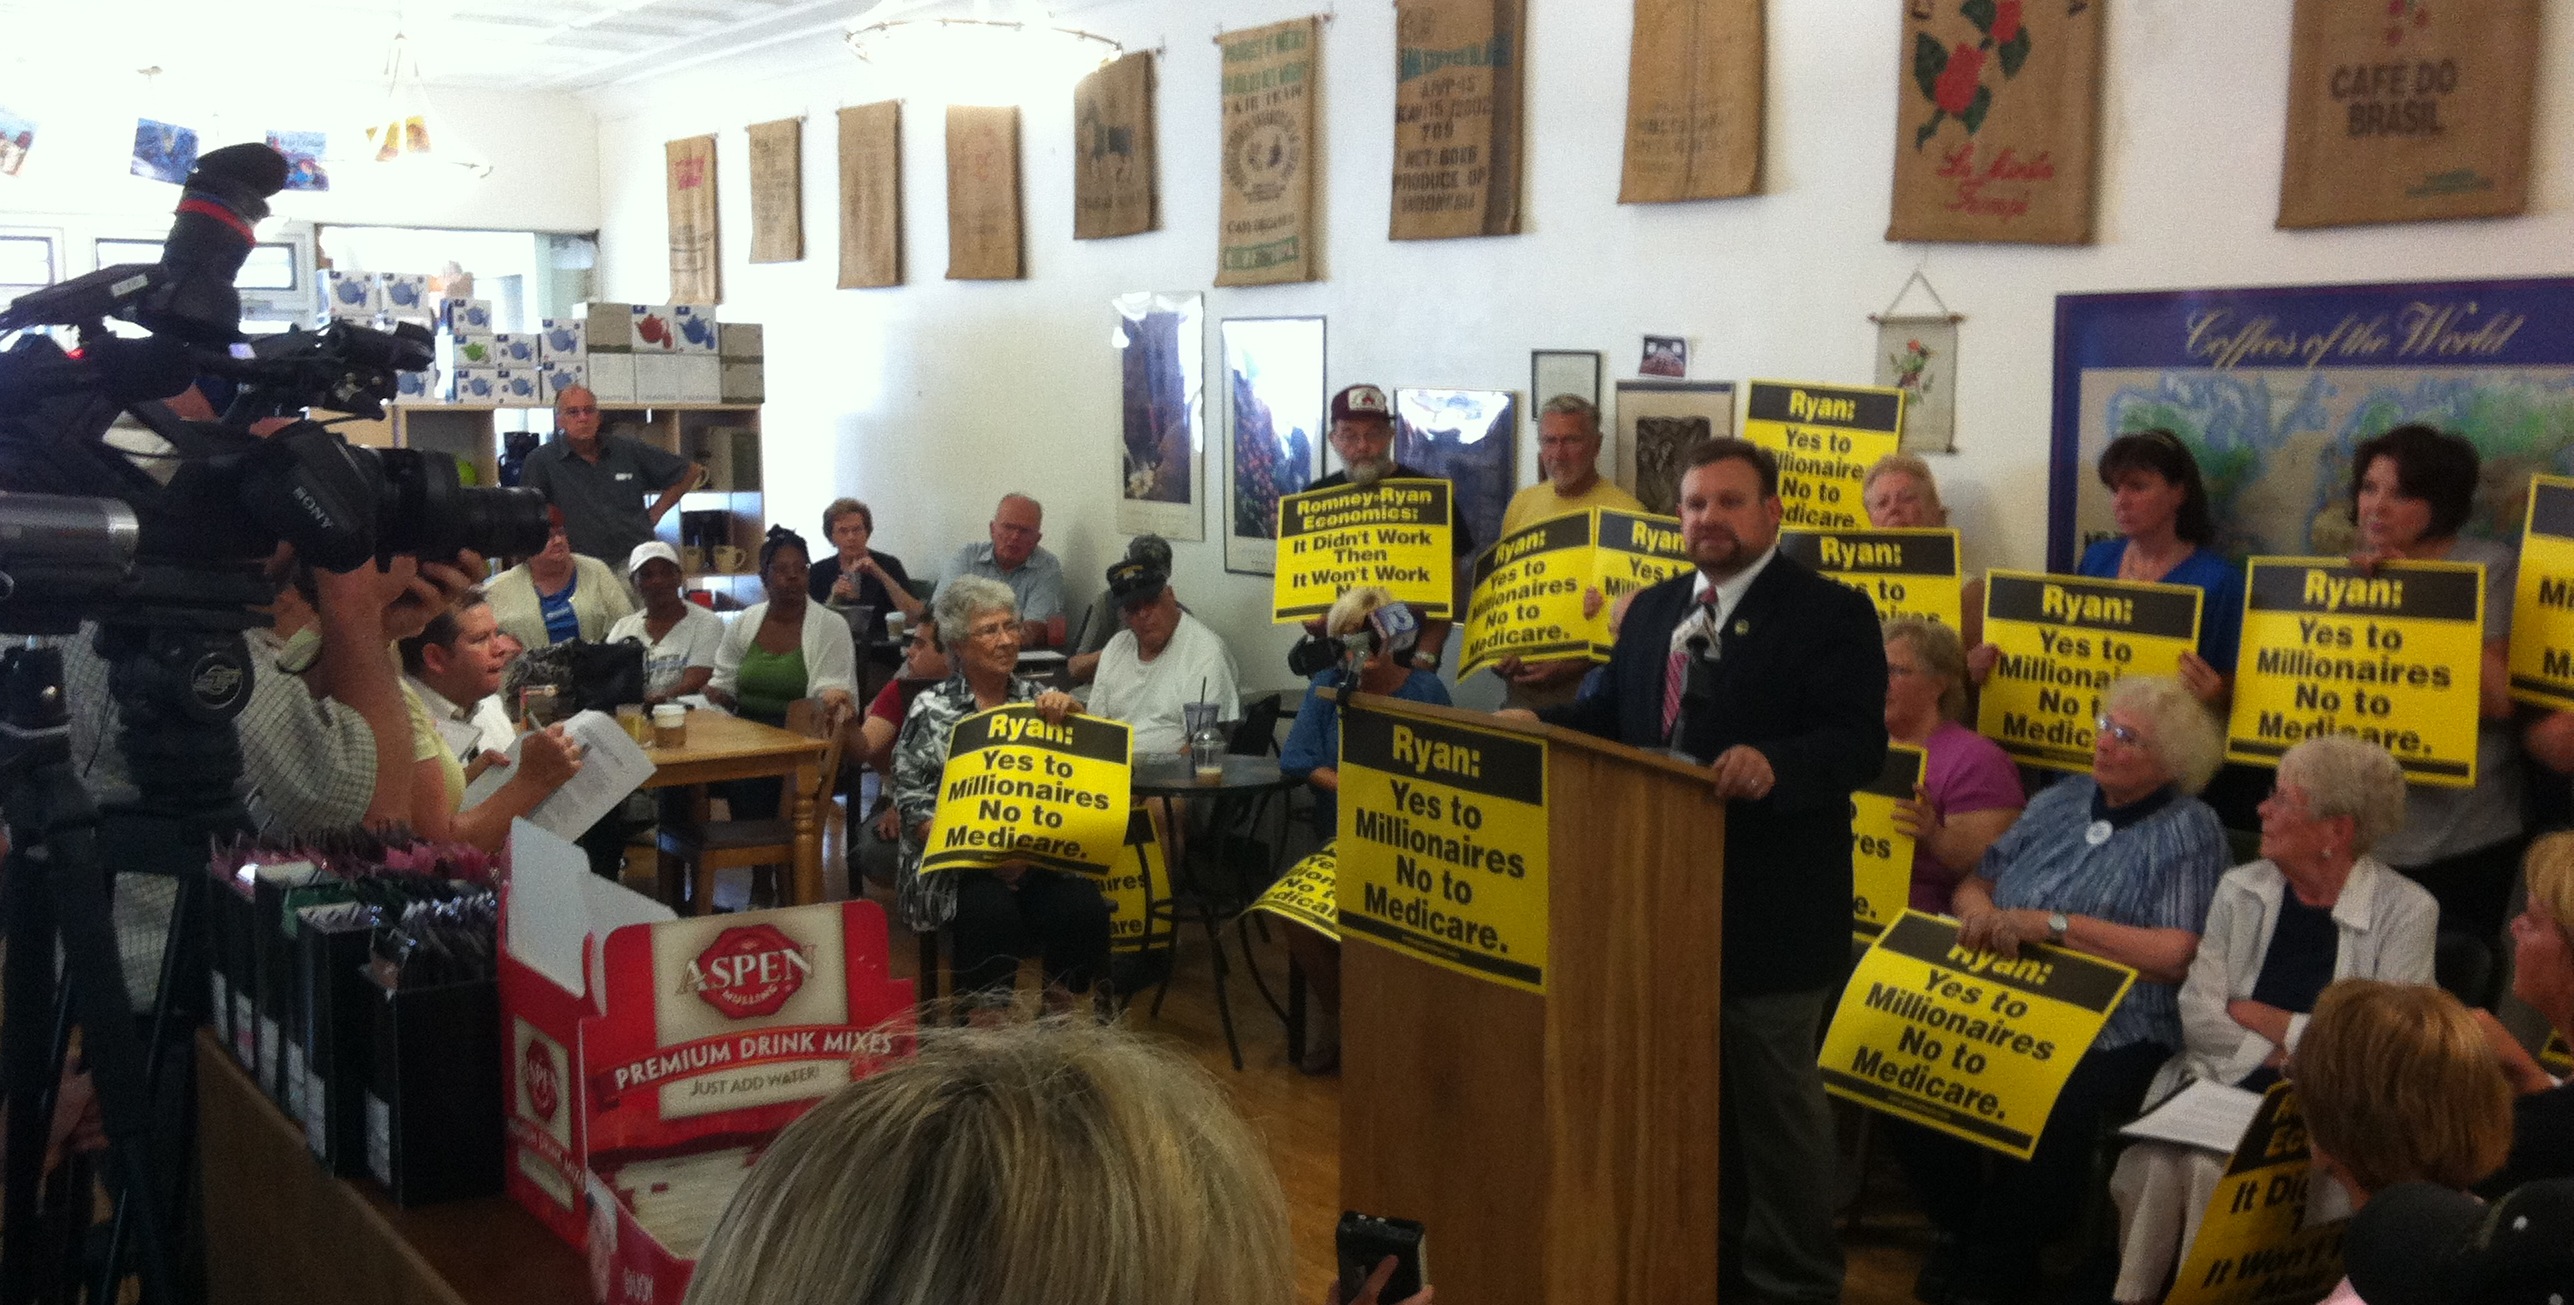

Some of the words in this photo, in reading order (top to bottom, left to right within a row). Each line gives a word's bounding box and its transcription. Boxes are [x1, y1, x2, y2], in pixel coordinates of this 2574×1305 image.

[2331, 63, 2405, 98] CAFE
[2416, 58, 2457, 95] DO
[2347, 100, 2446, 137] BRASIL
[2186, 306, 2297, 369] Coffees
[2303, 312, 2360, 369] of
[2339, 313, 2391, 356] the
[2401, 300, 2526, 356] World
[1789, 389, 1856, 422] Ryan:
[1786, 425, 1821, 451] Yes
[1830, 432, 1851, 453] to
[1298, 487, 1431, 515] Romney-Ryan
[1782, 477, 1811, 498] No
[1819, 481, 1840, 502] to
[293, 486, 334, 528] SONY
[1304, 506, 1418, 530] Economics:
[1294, 540, 1306, 553] It
[1313, 530, 1369, 550] Didn't
[1377, 529, 1431, 545] Work
[1632, 519, 1685, 552] Ryan
[1335, 549, 1387, 563] Then
[1629, 556, 1664, 580] Yes
[1820, 536, 1903, 571] Ryan:
[1293, 574, 1306, 588] It
[1313, 567, 1368, 585] Won't
[1375, 565, 1430, 582] Work
[1491, 567, 1517, 590] Yes
[1525, 560, 1545, 577] to
[1878, 579, 1906, 601] to
[2304, 569, 2404, 612] Ryan:
[1486, 610, 1508, 629] No
[1517, 603, 1539, 621] to
[2042, 583, 2133, 624] Ryan:
[2038, 626, 2091, 658] Yes
[2103, 637, 2132, 663] to
[2300, 618, 2353, 646] Yes
[2367, 623, 2403, 651] to
[2257, 647, 2452, 688] Millionaires
[2038, 688, 2080, 715] No
[2091, 695, 2100, 717] t
[2295, 683, 2341, 712] No
[2355, 689, 2392, 717] to
[988, 714, 1073, 745] Ryan:
[2003, 711, 2091, 747] Medic
[983, 750, 1033, 771] Yes
[1045, 755, 1073, 778] to
[1393, 725, 1481, 777] Ryan:
[948, 774, 1109, 811] Millionaires
[1390, 779, 1442, 820] Yes
[1451, 795, 1482, 830] to
[979, 800, 1021, 822] No
[1032, 805, 1063, 828] to
[945, 825, 1087, 858] Medicare.
[1356, 807, 1525, 879] Millionaires
[1397, 855, 1432, 892] No
[1443, 870, 1472, 905] to
[1365, 882, 1508, 953] Medicare.
[675, 944, 817, 997] ASPEN
[722, 984, 778, 1006] MULLING
[1924, 968, 1983, 1005] Yes
[1990, 990, 2028, 1018] to
[1865, 981, 2056, 1061] Millionaires
[615, 1043, 731, 1091] PREMIUM
[740, 1031, 815, 1060] DRINK
[823, 1031, 892, 1055] MIXES
[1898, 1025, 1943, 1062] No
[1952, 1043, 1986, 1075] to
[690, 1077, 727, 1098] JUST
[730, 1073, 764, 1093] ADD
[767, 1065, 820, 1087] WATER!
[1851, 1045, 2006, 1120] Medicare.
[2231, 1181, 2258, 1213] It
[2201, 1259, 2232, 1289] It
